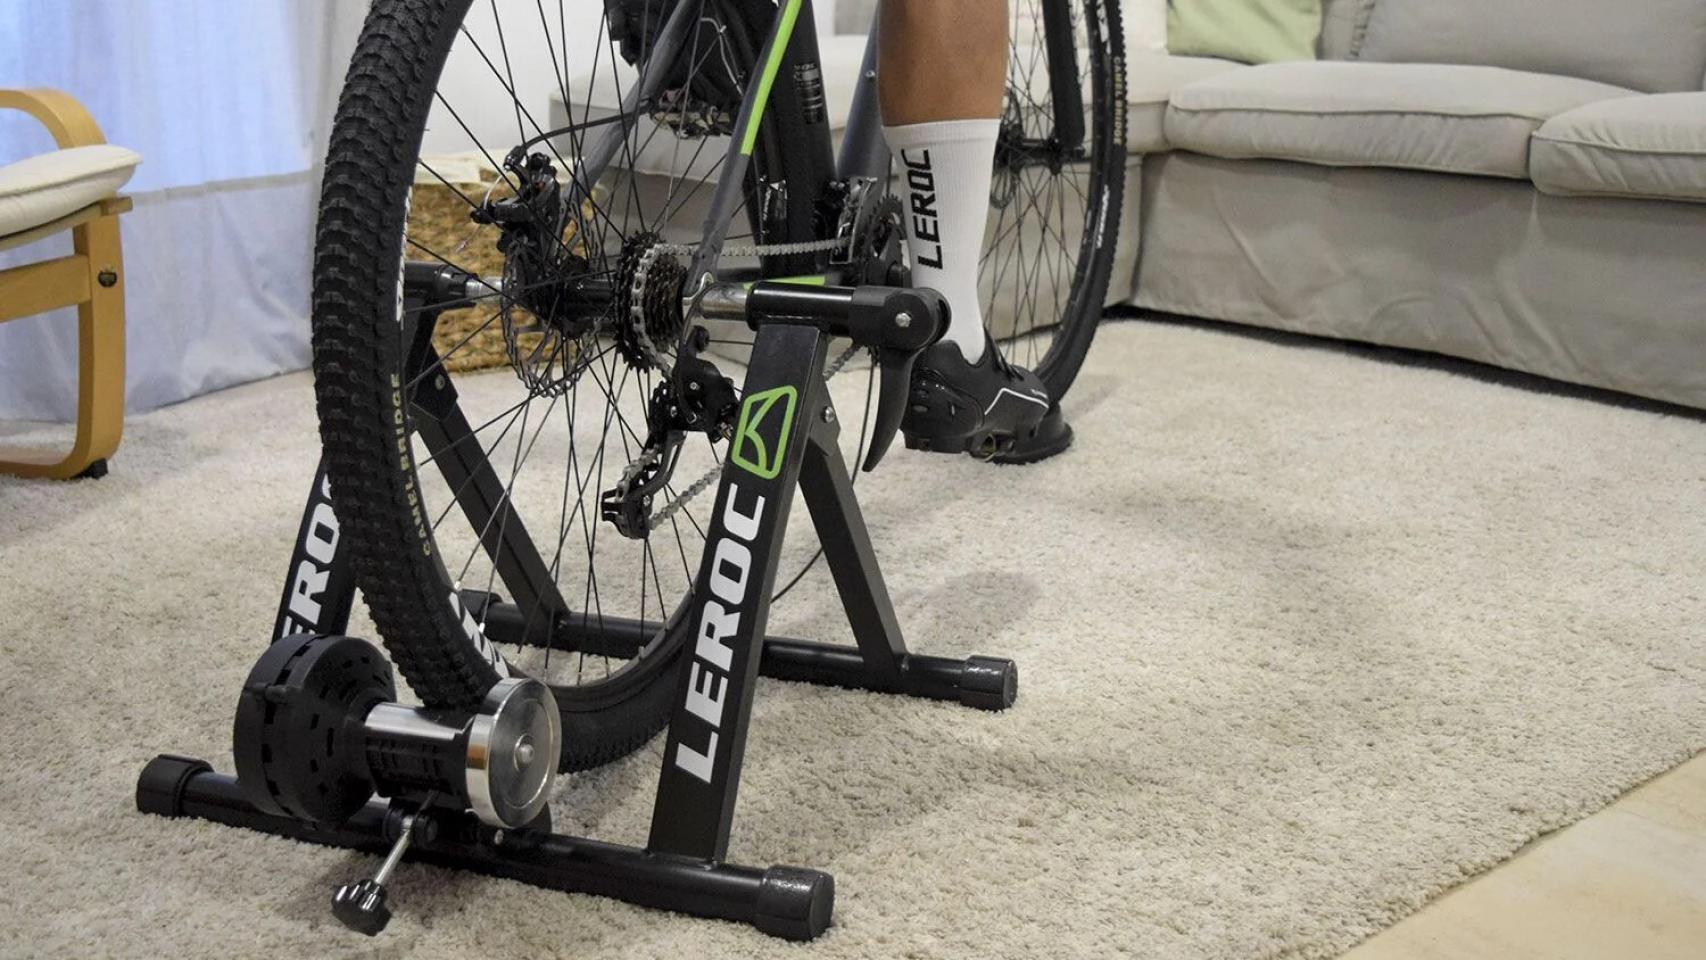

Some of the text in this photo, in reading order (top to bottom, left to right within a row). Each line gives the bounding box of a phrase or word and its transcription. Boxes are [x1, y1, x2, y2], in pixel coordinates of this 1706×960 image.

[1113, 56, 1123, 146] CAMEL BRIDGE
[901, 148, 943, 269] LEROC
[405, 475, 432, 556] CAMEL
[675, 482, 765, 784] LEROC
